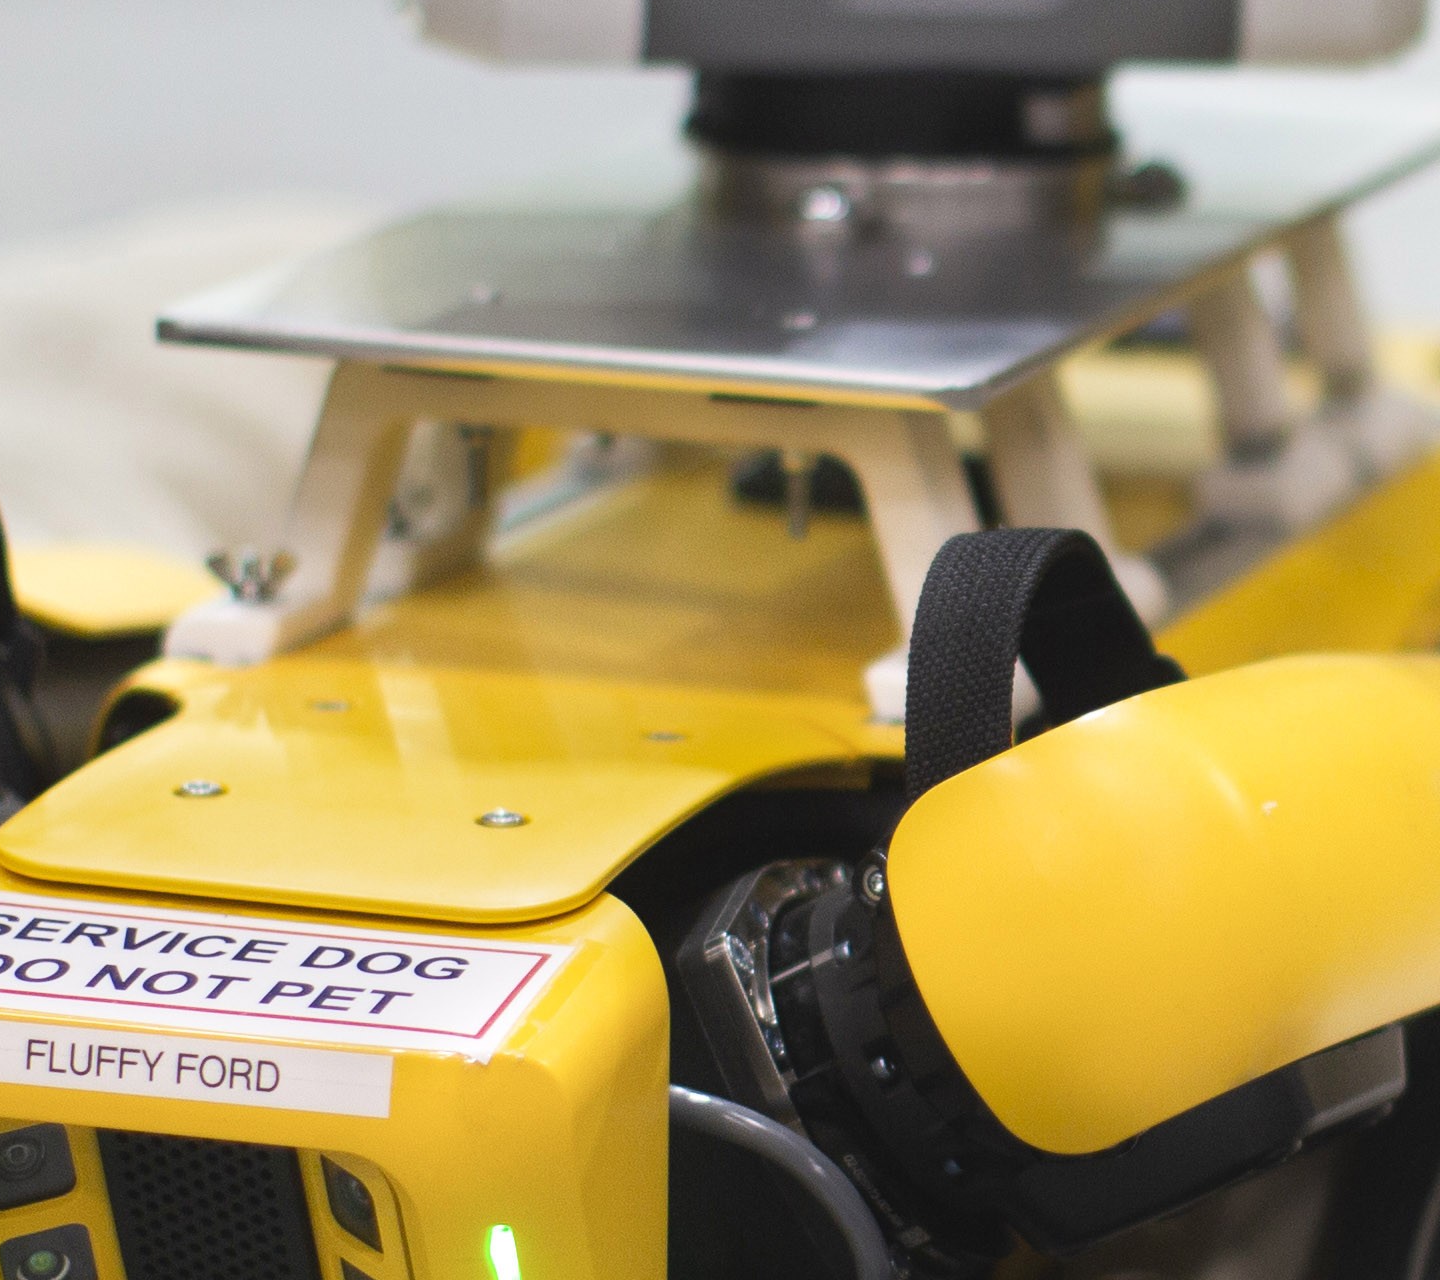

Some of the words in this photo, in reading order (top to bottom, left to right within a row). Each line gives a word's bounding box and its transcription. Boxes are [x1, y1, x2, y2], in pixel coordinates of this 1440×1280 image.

[299, 945, 469, 980] DOG
[85, 964, 250, 999] NOT
[259, 980, 413, 1014] PET
[25, 1038, 164, 1082] FLUFFY
[175, 1051, 280, 1093] FORD
